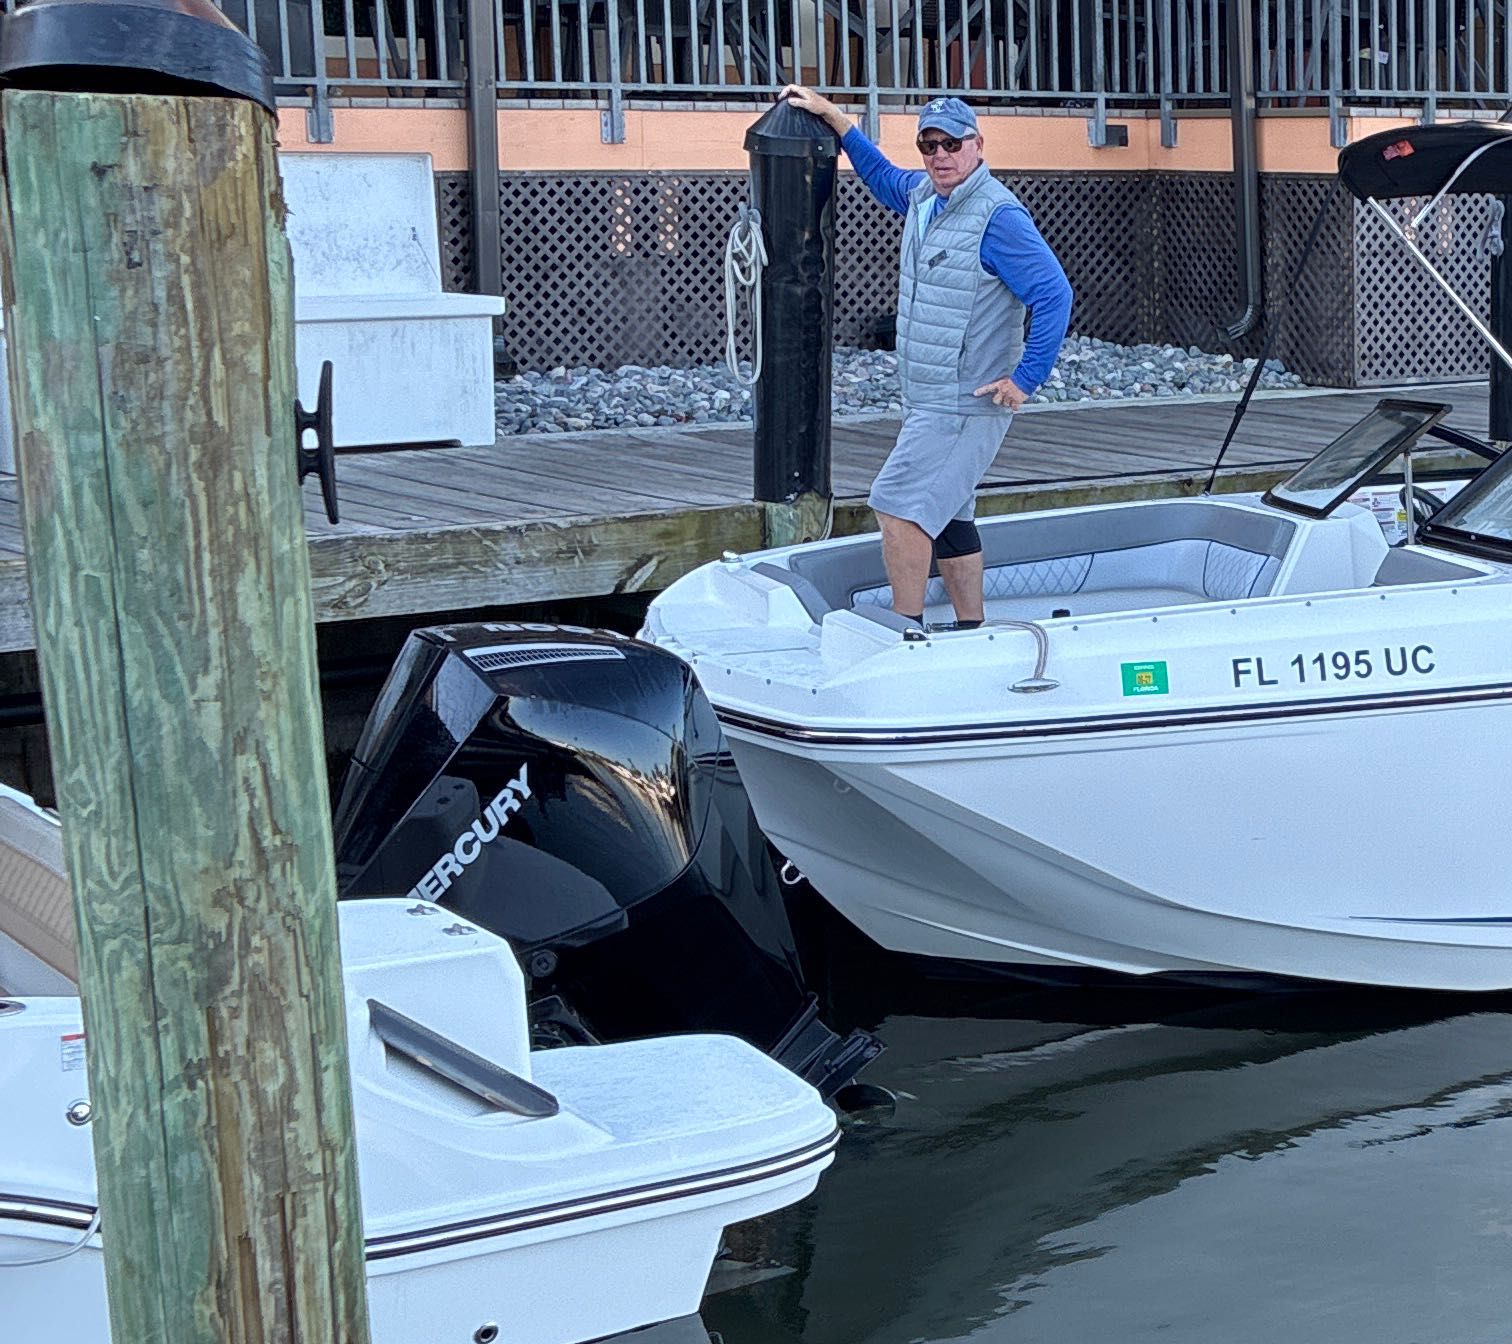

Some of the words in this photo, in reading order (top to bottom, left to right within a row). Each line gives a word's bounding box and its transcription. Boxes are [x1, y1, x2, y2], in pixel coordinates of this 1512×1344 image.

[1231, 657, 1279, 688] FL
[1290, 649, 1373, 683] 1195
[1384, 644, 1436, 676] UC
